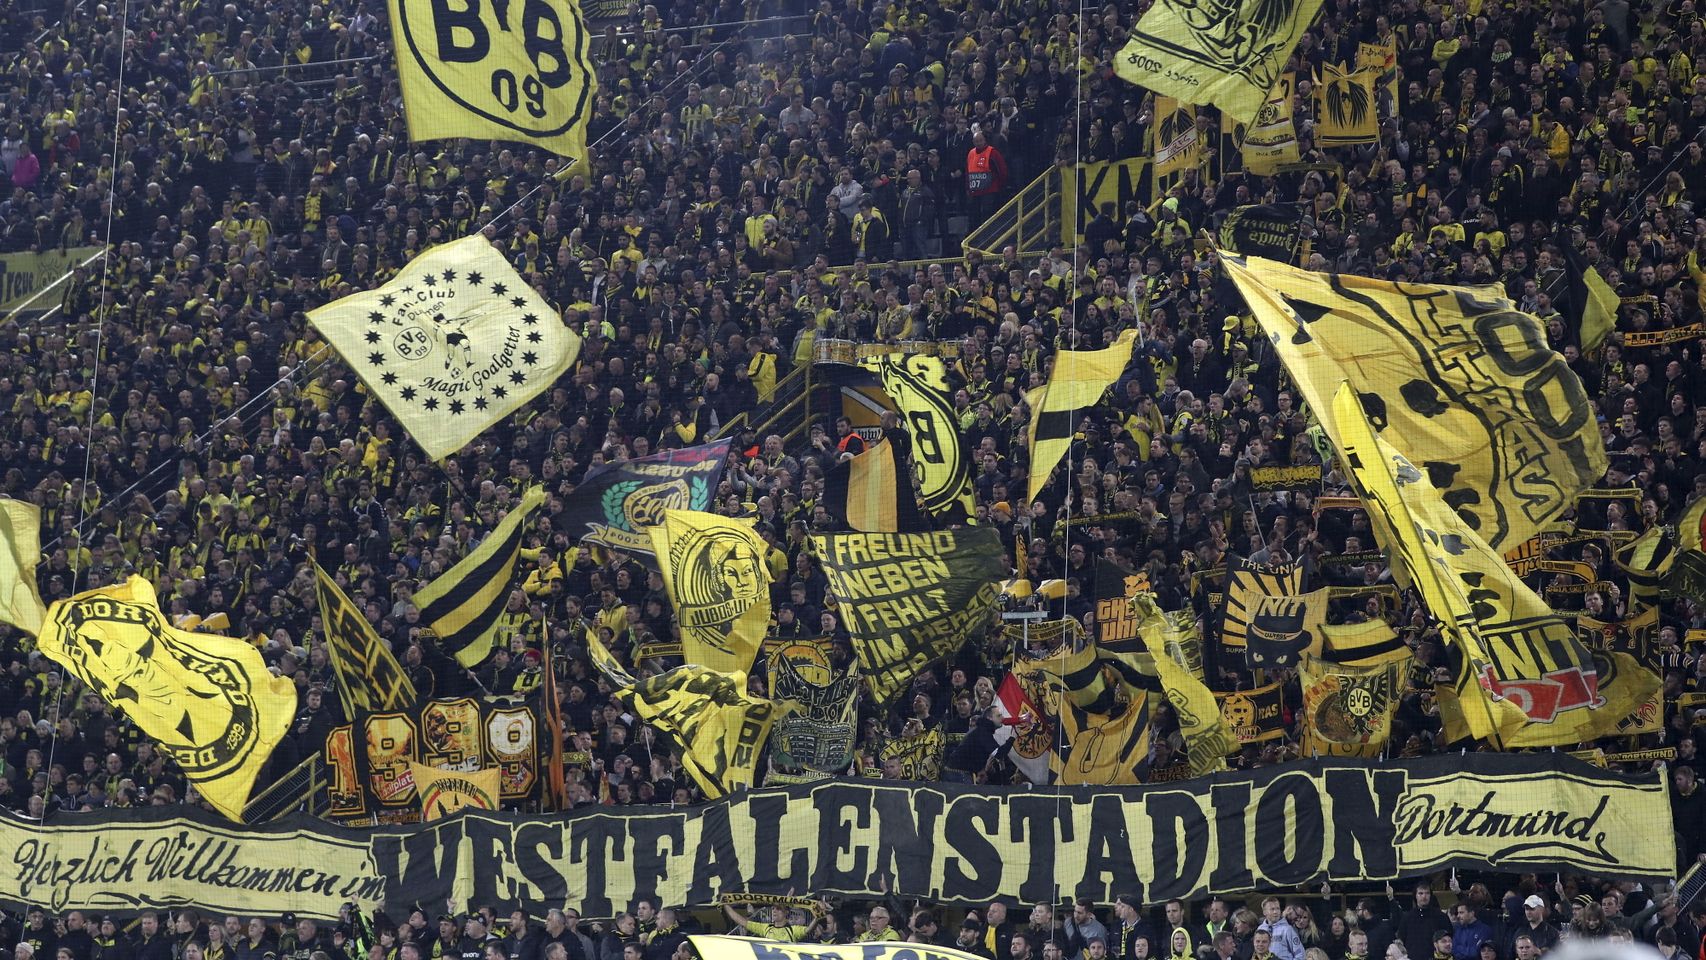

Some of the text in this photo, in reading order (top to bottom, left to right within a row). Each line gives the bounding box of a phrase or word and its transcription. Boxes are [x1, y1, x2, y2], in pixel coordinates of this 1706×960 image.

[491, 69, 547, 118] 09
[392, 288, 456, 327] Fan-Club
[397, 331, 427, 356] BVB
[414, 345, 427, 357] 09
[419, 325, 520, 397] Magic Goalgetter
[833, 530, 956, 566] FREUND
[1240, 558, 1265, 573] THE
[841, 555, 950, 600] NEBEN
[857, 588, 950, 633] FEHLT
[1349, 690, 1371, 709] BVB
[326, 697, 538, 816] 1999
[1394, 790, 1609, 847] Dortmund
[373, 766, 1408, 918] WESTFALENSTADION
[14, 831, 387, 911] Herzlich Willkommen im
